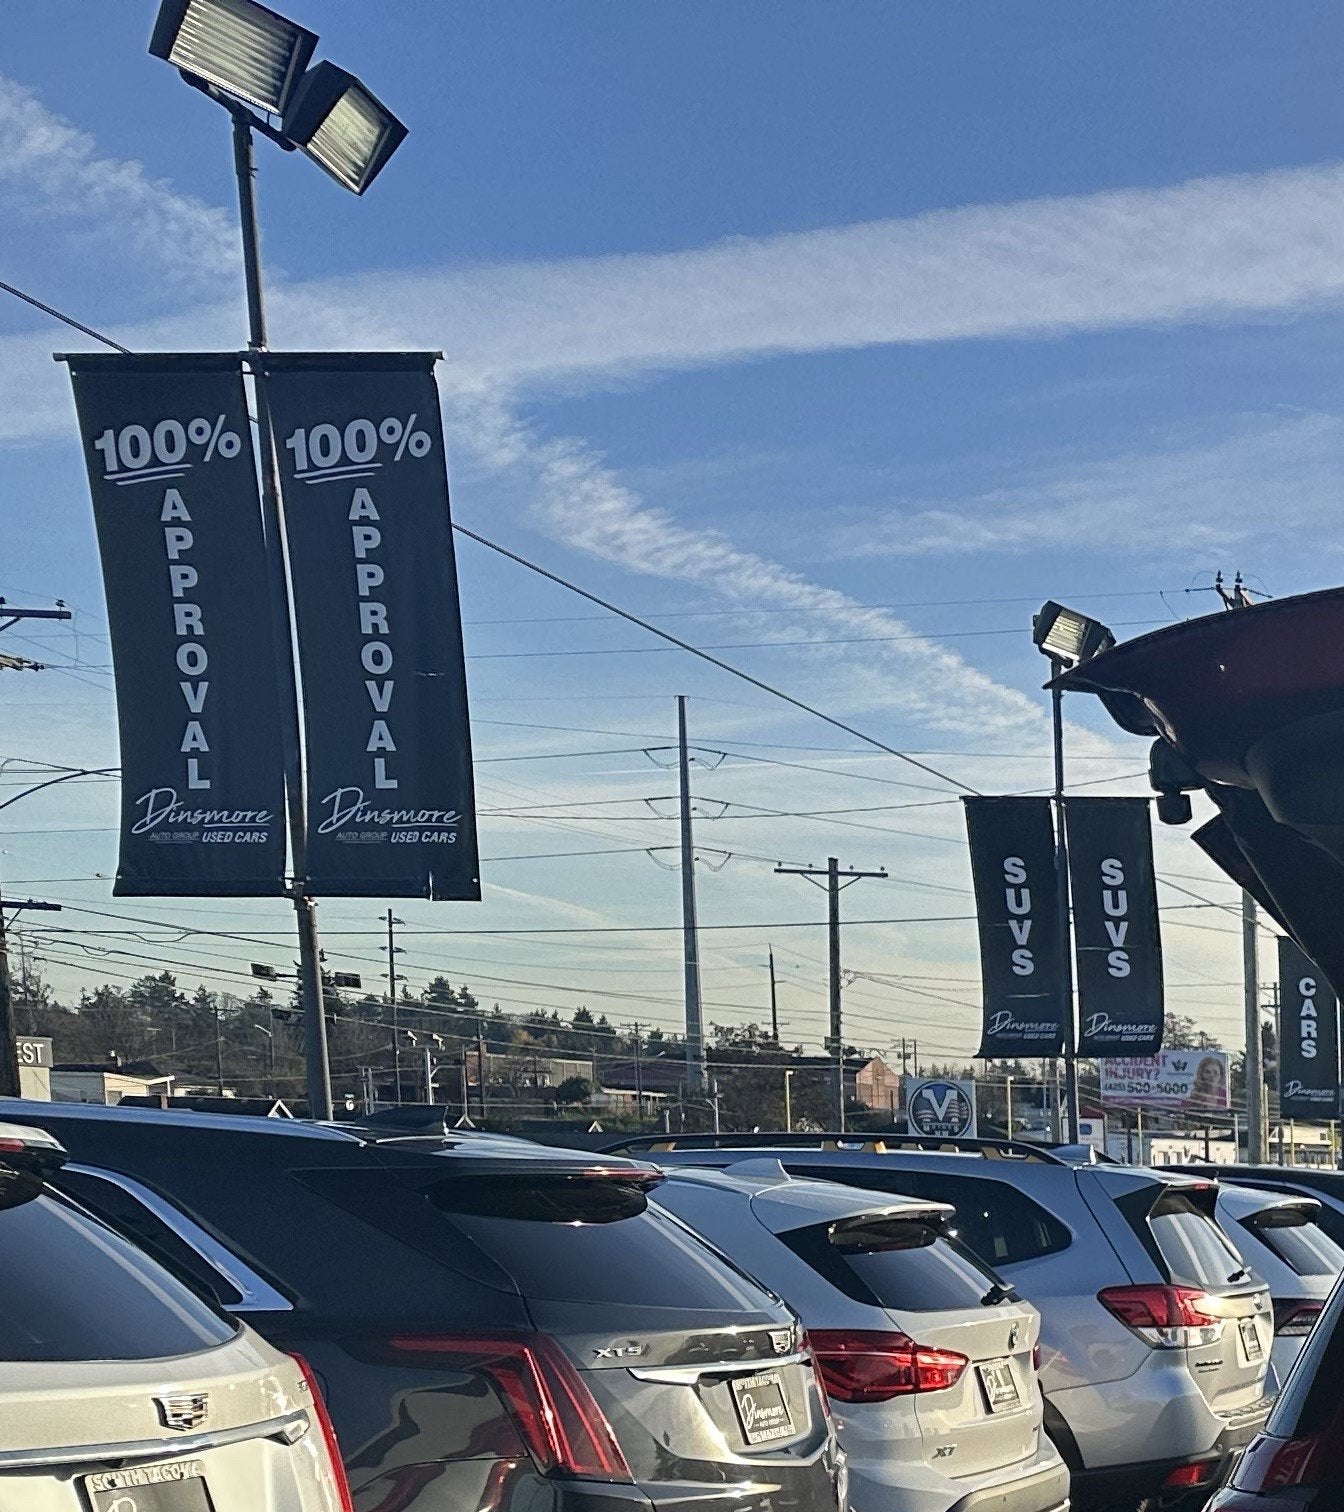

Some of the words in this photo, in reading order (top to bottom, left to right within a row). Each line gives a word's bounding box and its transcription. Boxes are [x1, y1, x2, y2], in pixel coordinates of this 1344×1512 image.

[95, 414, 241, 473] 100%
[286, 413, 432, 472] 100%
[160, 488, 211, 790] APPROVAL
[348, 487, 398, 790] APPROVAL
[131, 787, 274, 835] Dinsmore
[202, 831, 233, 843] USED
[234, 831, 268, 843] CARS
[317, 786, 462, 834] Dinsmore
[390, 831, 419, 843] USED
[421, 831, 457, 843] CARS
[1003, 856, 1035, 976] SUVS
[1101, 858, 1131, 978] SUVS
[1298, 977, 1318, 1059] CARS
[1104, 1055, 1168, 1067] ACCIDENT
[1105, 1067, 1160, 1080] INJURY?
